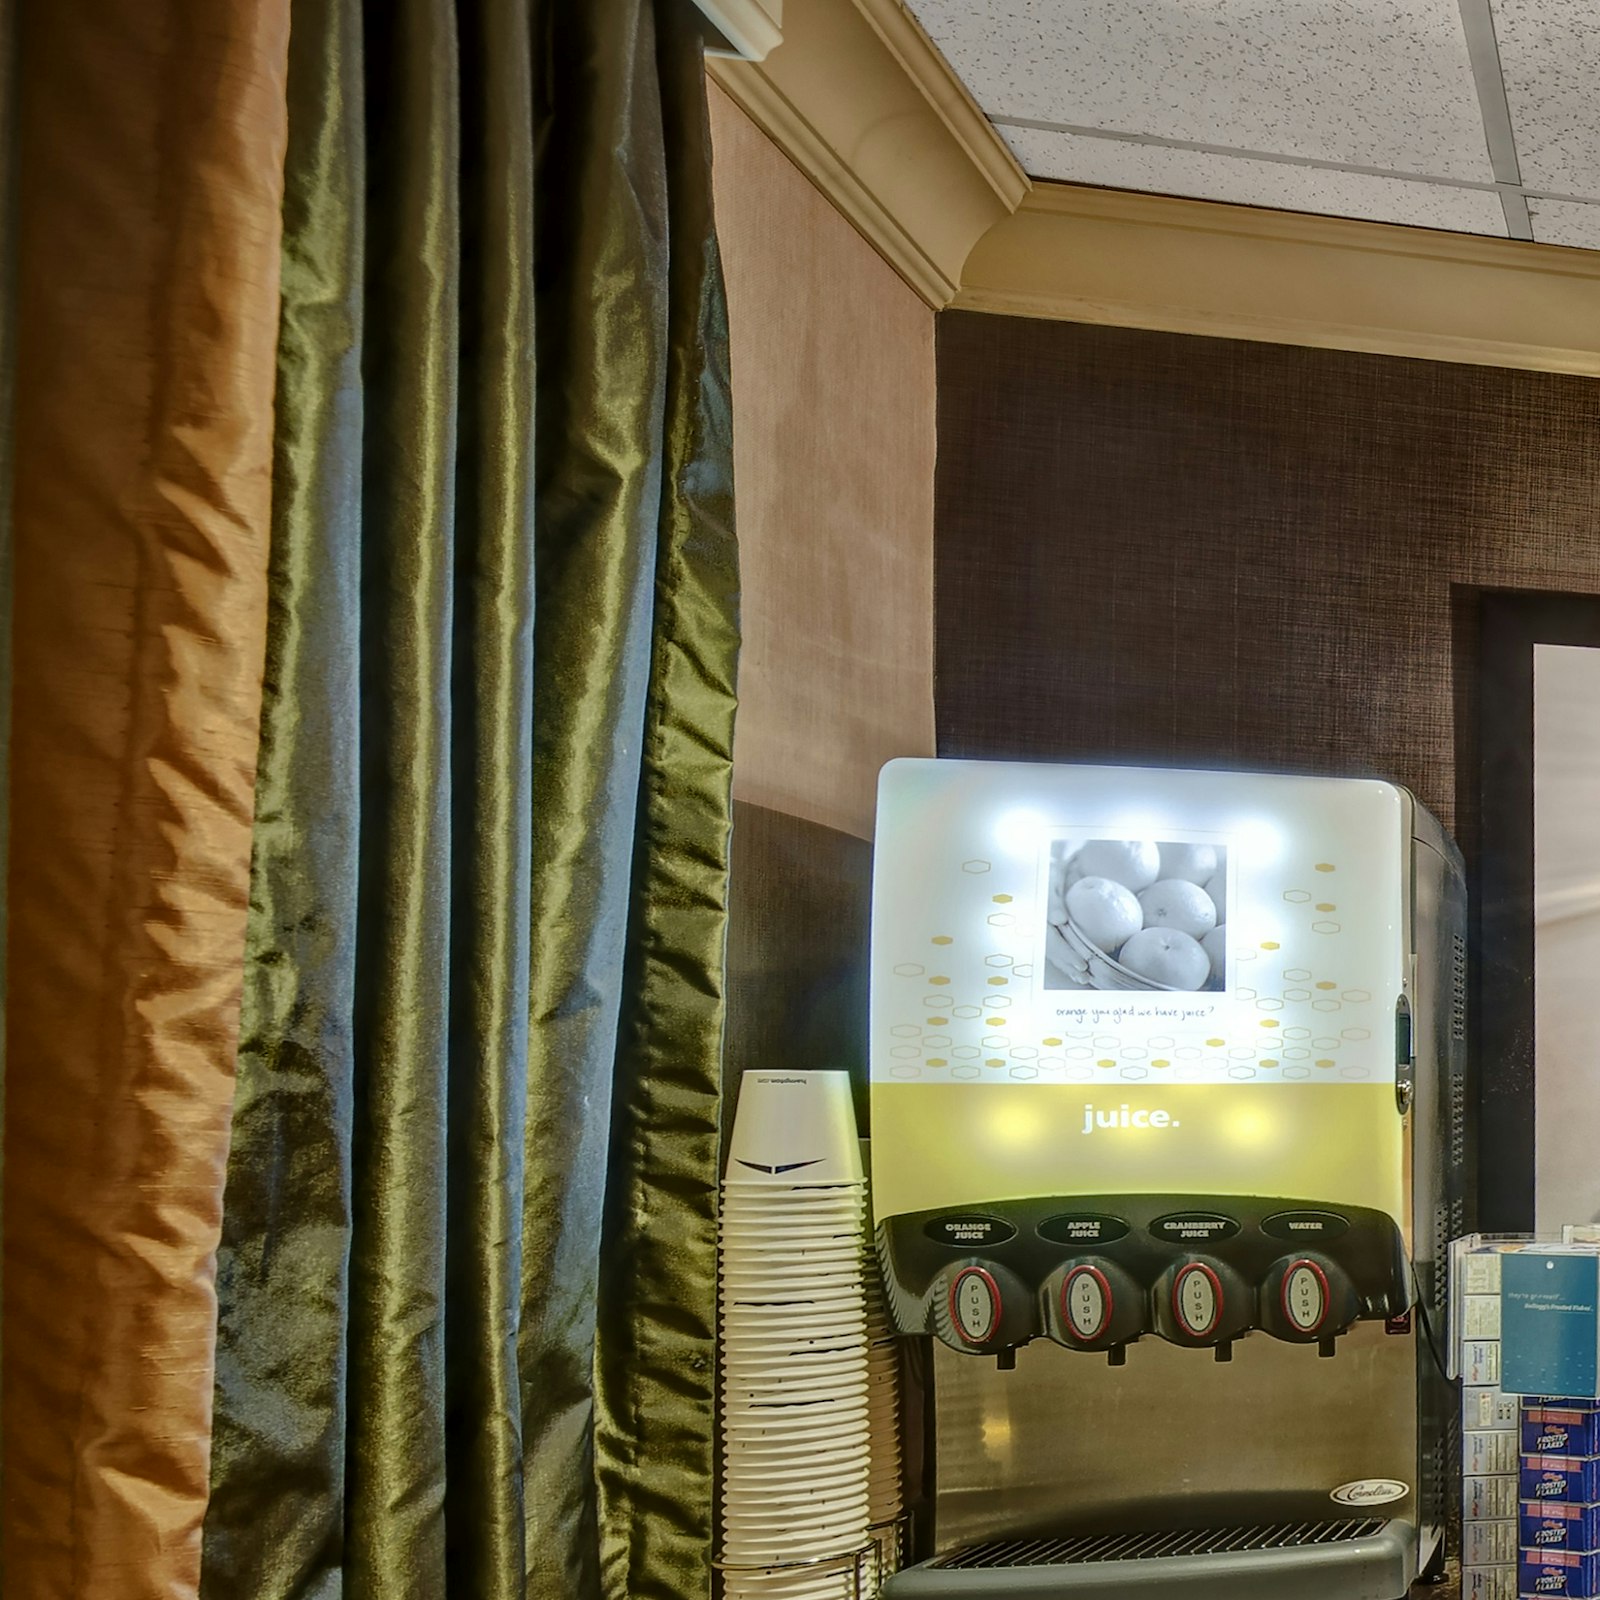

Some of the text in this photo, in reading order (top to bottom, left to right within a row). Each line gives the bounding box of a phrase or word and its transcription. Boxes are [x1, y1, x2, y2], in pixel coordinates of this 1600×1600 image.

[1056, 1008, 1088, 1024] orange
[1113, 1006, 1135, 1024] glad
[1155, 1007, 1177, 1016] have
[1082, 1104, 1180, 1135] juice.
[945, 1223, 991, 1232] ORANGE
[1067, 1222, 1101, 1230] APPLE
[1163, 1222, 1226, 1230] CRANBERRY
[1289, 1222, 1323, 1230] WATER
[954, 1232, 984, 1240] JUICE
[1070, 1230, 1100, 1238] JUICE
[1180, 1230, 1209, 1238] JUICE
[1193, 1280, 1203, 1322] PUSH
[1300, 1277, 1310, 1318] PUSH
[970, 1285, 981, 1328] PUSH
[1082, 1283, 1092, 1325] PUSH
